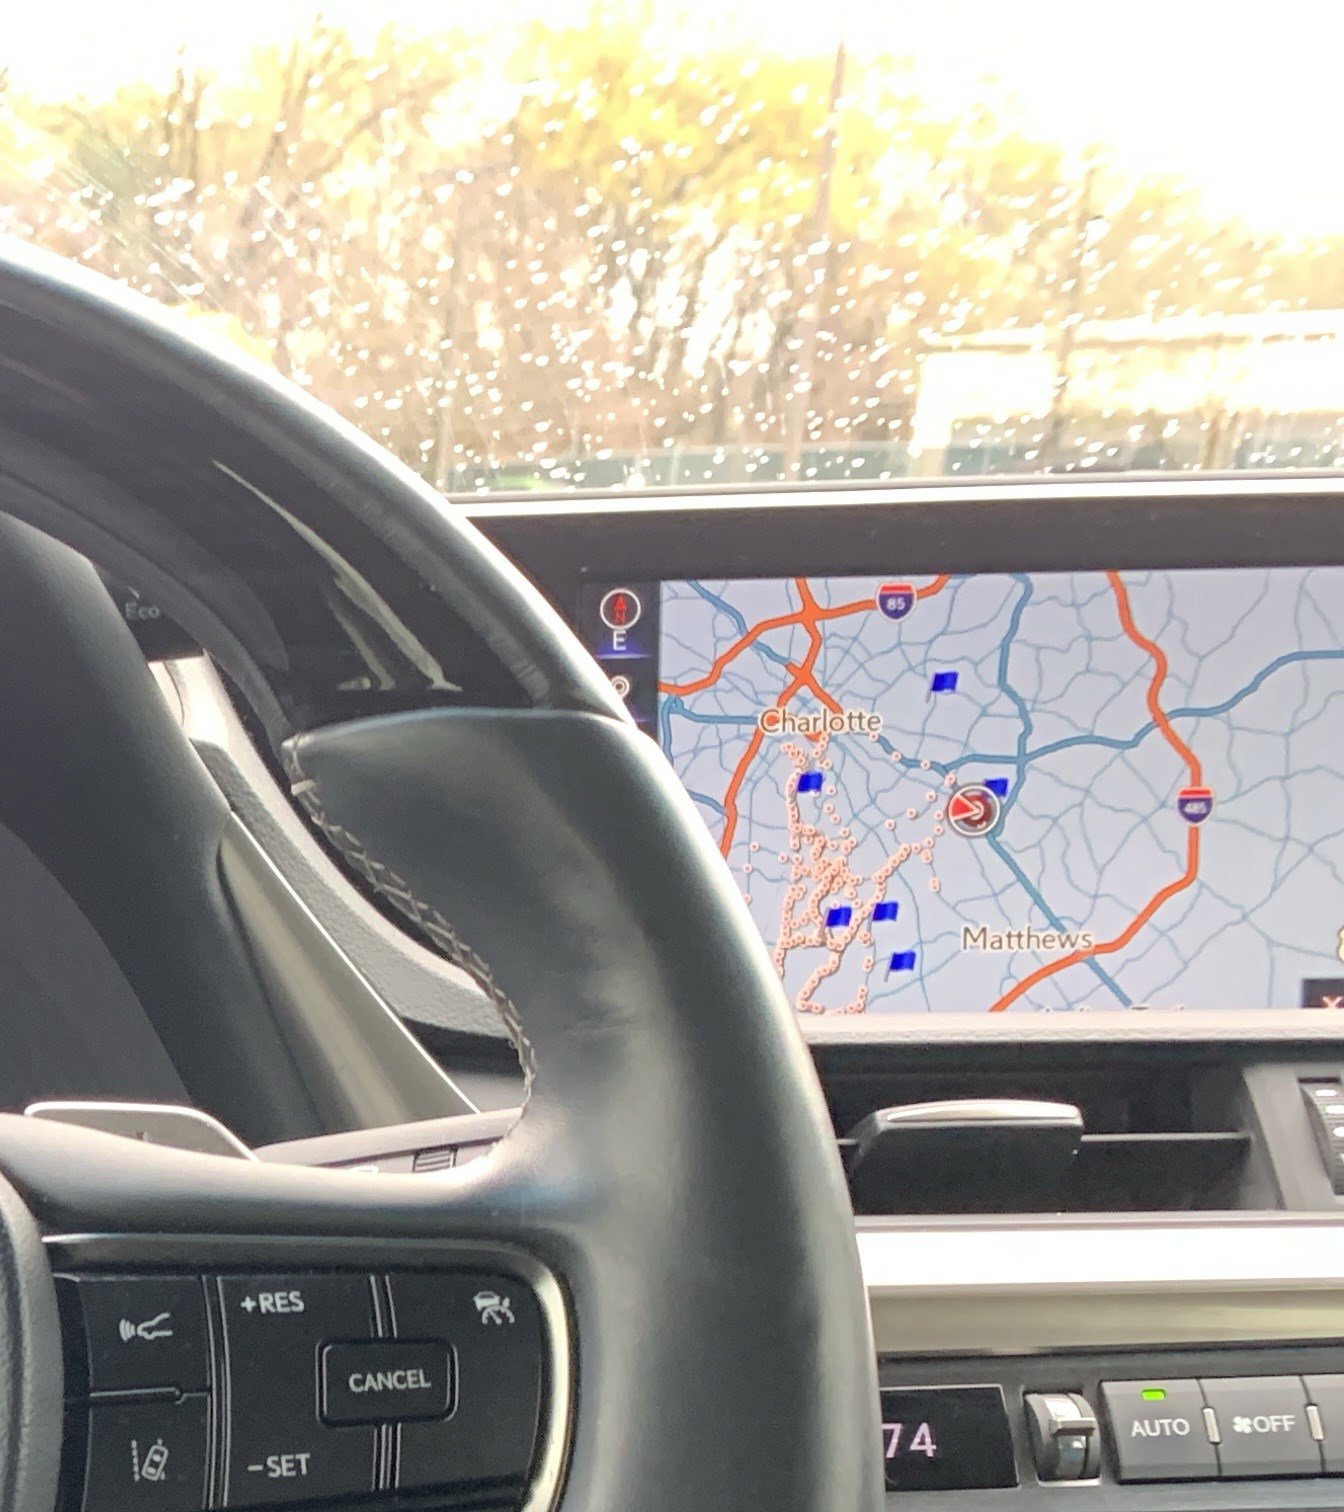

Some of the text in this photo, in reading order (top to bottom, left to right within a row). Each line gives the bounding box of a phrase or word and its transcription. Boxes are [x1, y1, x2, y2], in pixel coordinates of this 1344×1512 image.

[612, 630, 628, 651] E
[761, 708, 882, 733] Charlotte
[962, 926, 1093, 951] Matthews
[348, 1371, 432, 1393] CANCEL
[1131, 1418, 1190, 1438] AUTO
[1254, 1415, 1296, 1434] OFF
[881, 1422, 937, 1458] 74
